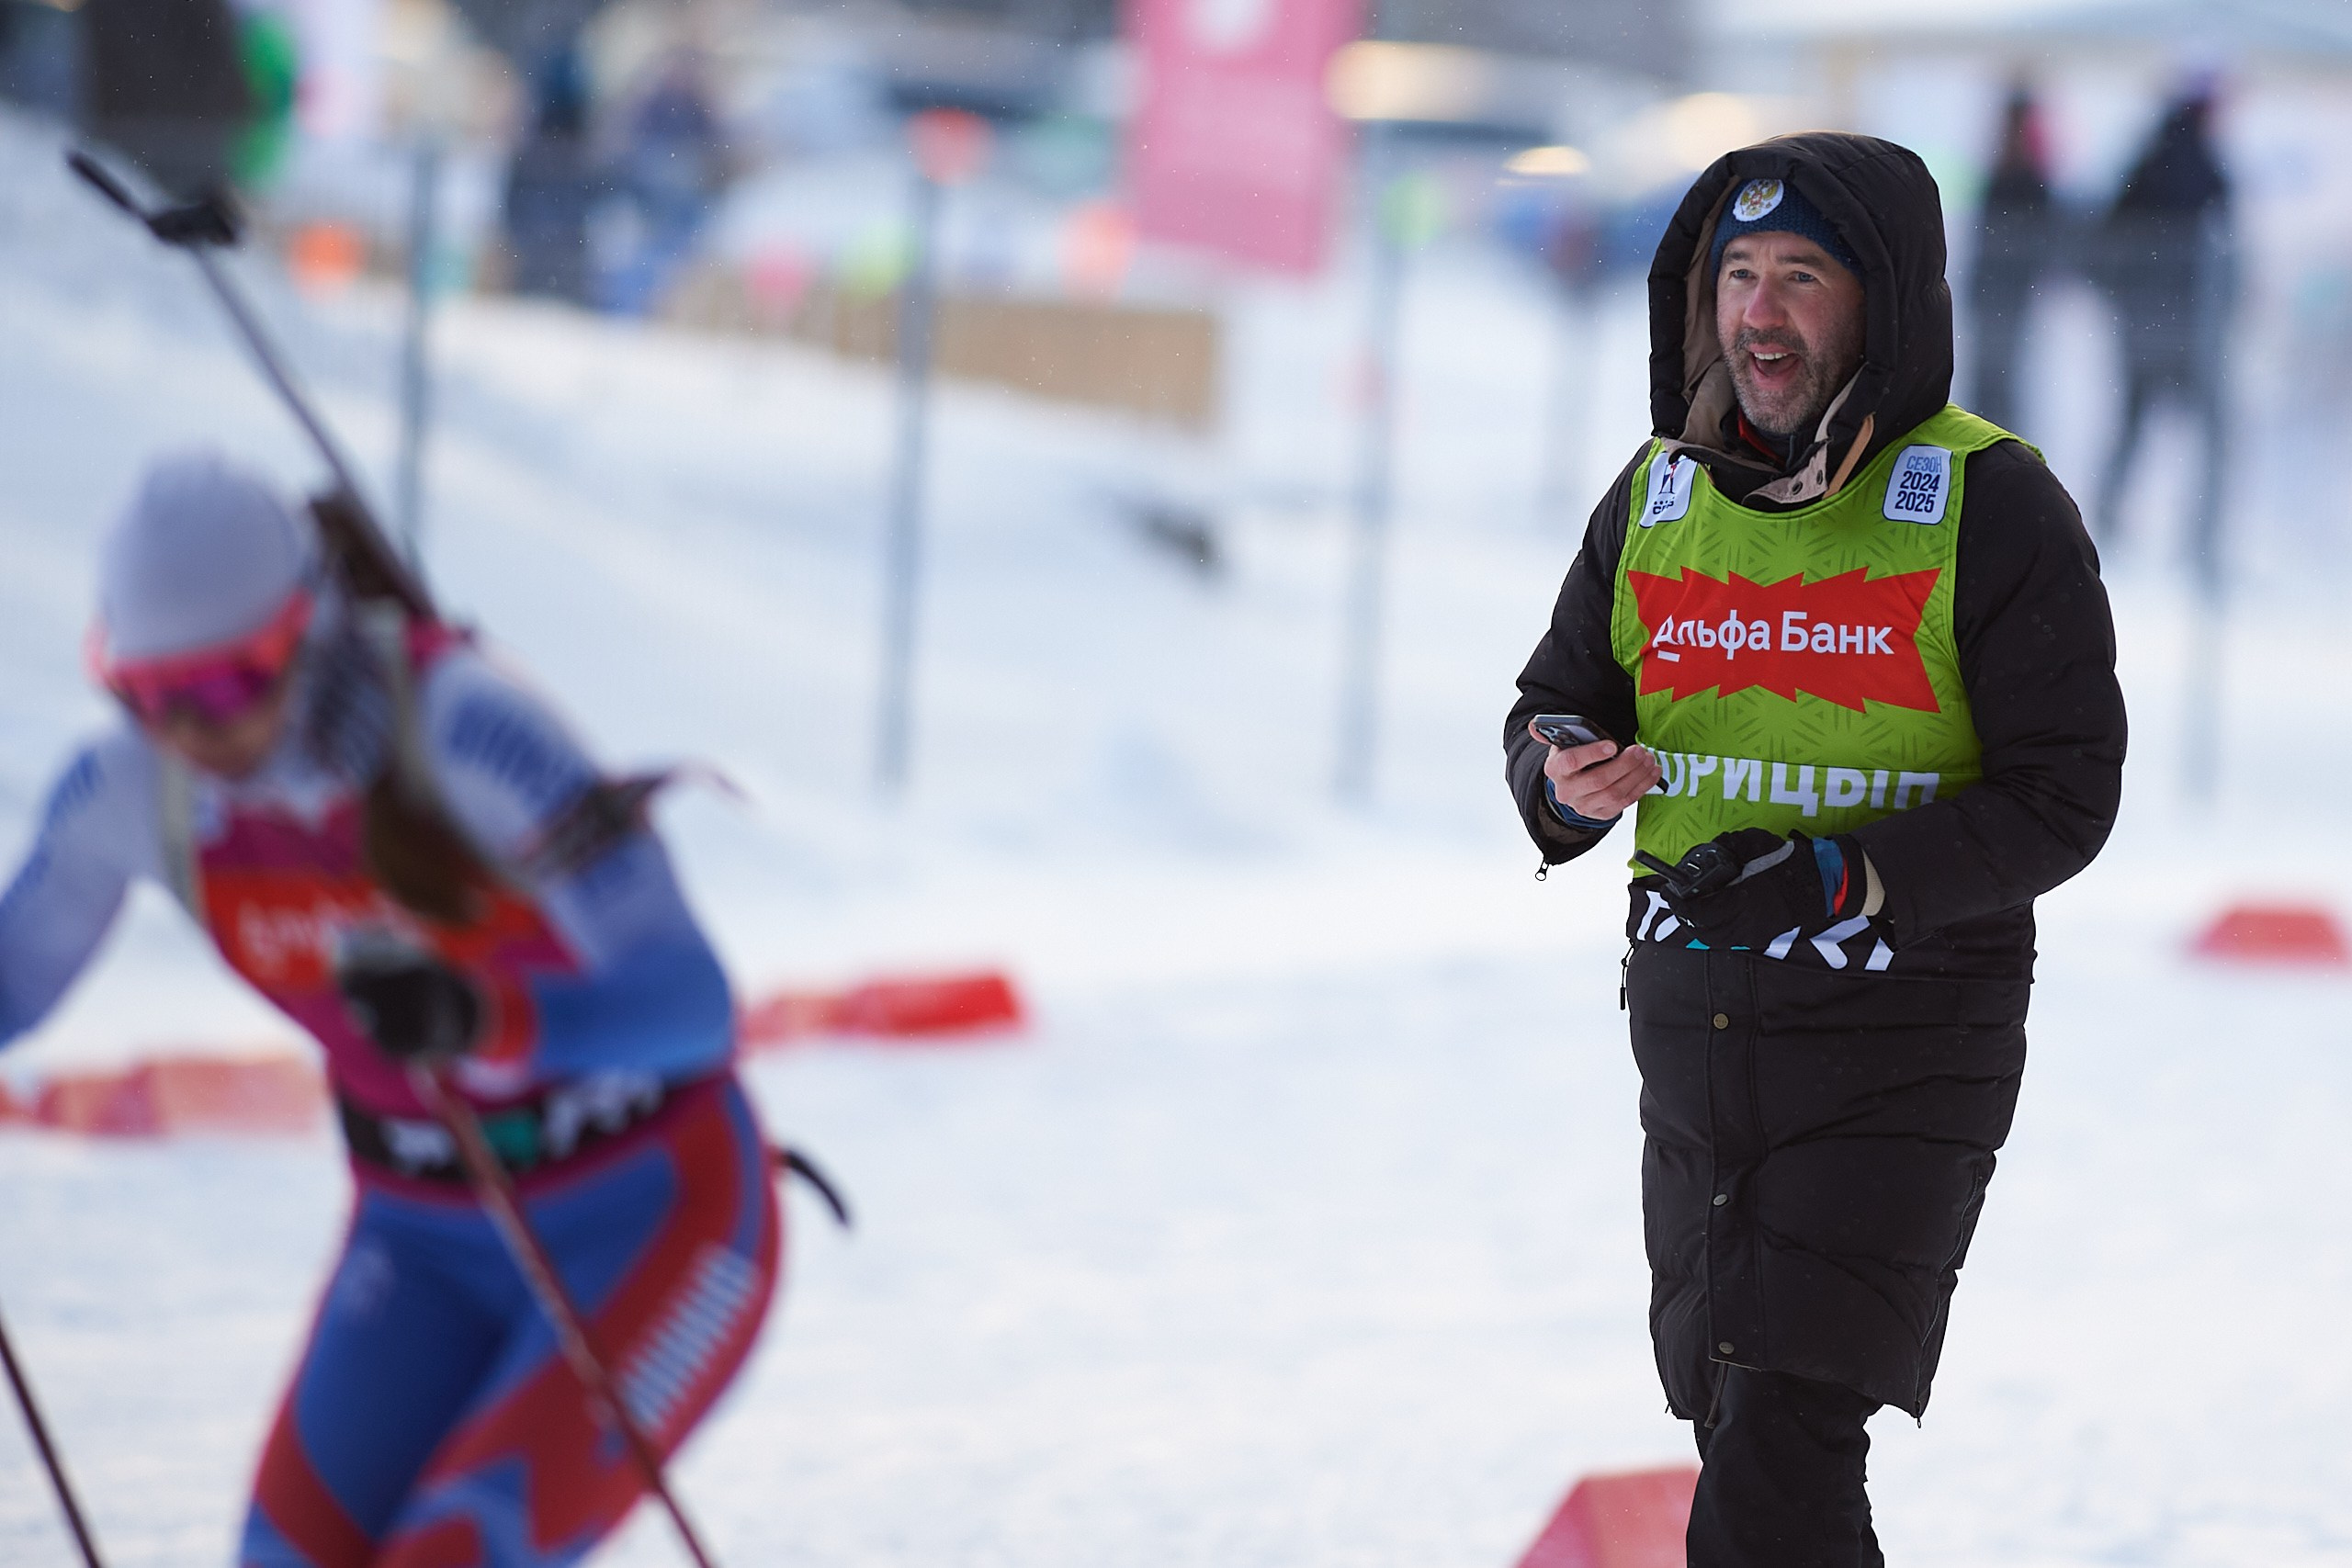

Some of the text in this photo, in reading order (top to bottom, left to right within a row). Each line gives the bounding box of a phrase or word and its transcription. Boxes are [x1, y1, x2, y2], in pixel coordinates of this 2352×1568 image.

[1906, 455, 1942, 473] СЕЗОН
[1899, 469, 1940, 492] 2024
[1894, 490, 1936, 513] 2025
[1652, 609, 1894, 662] Альфа Банк
